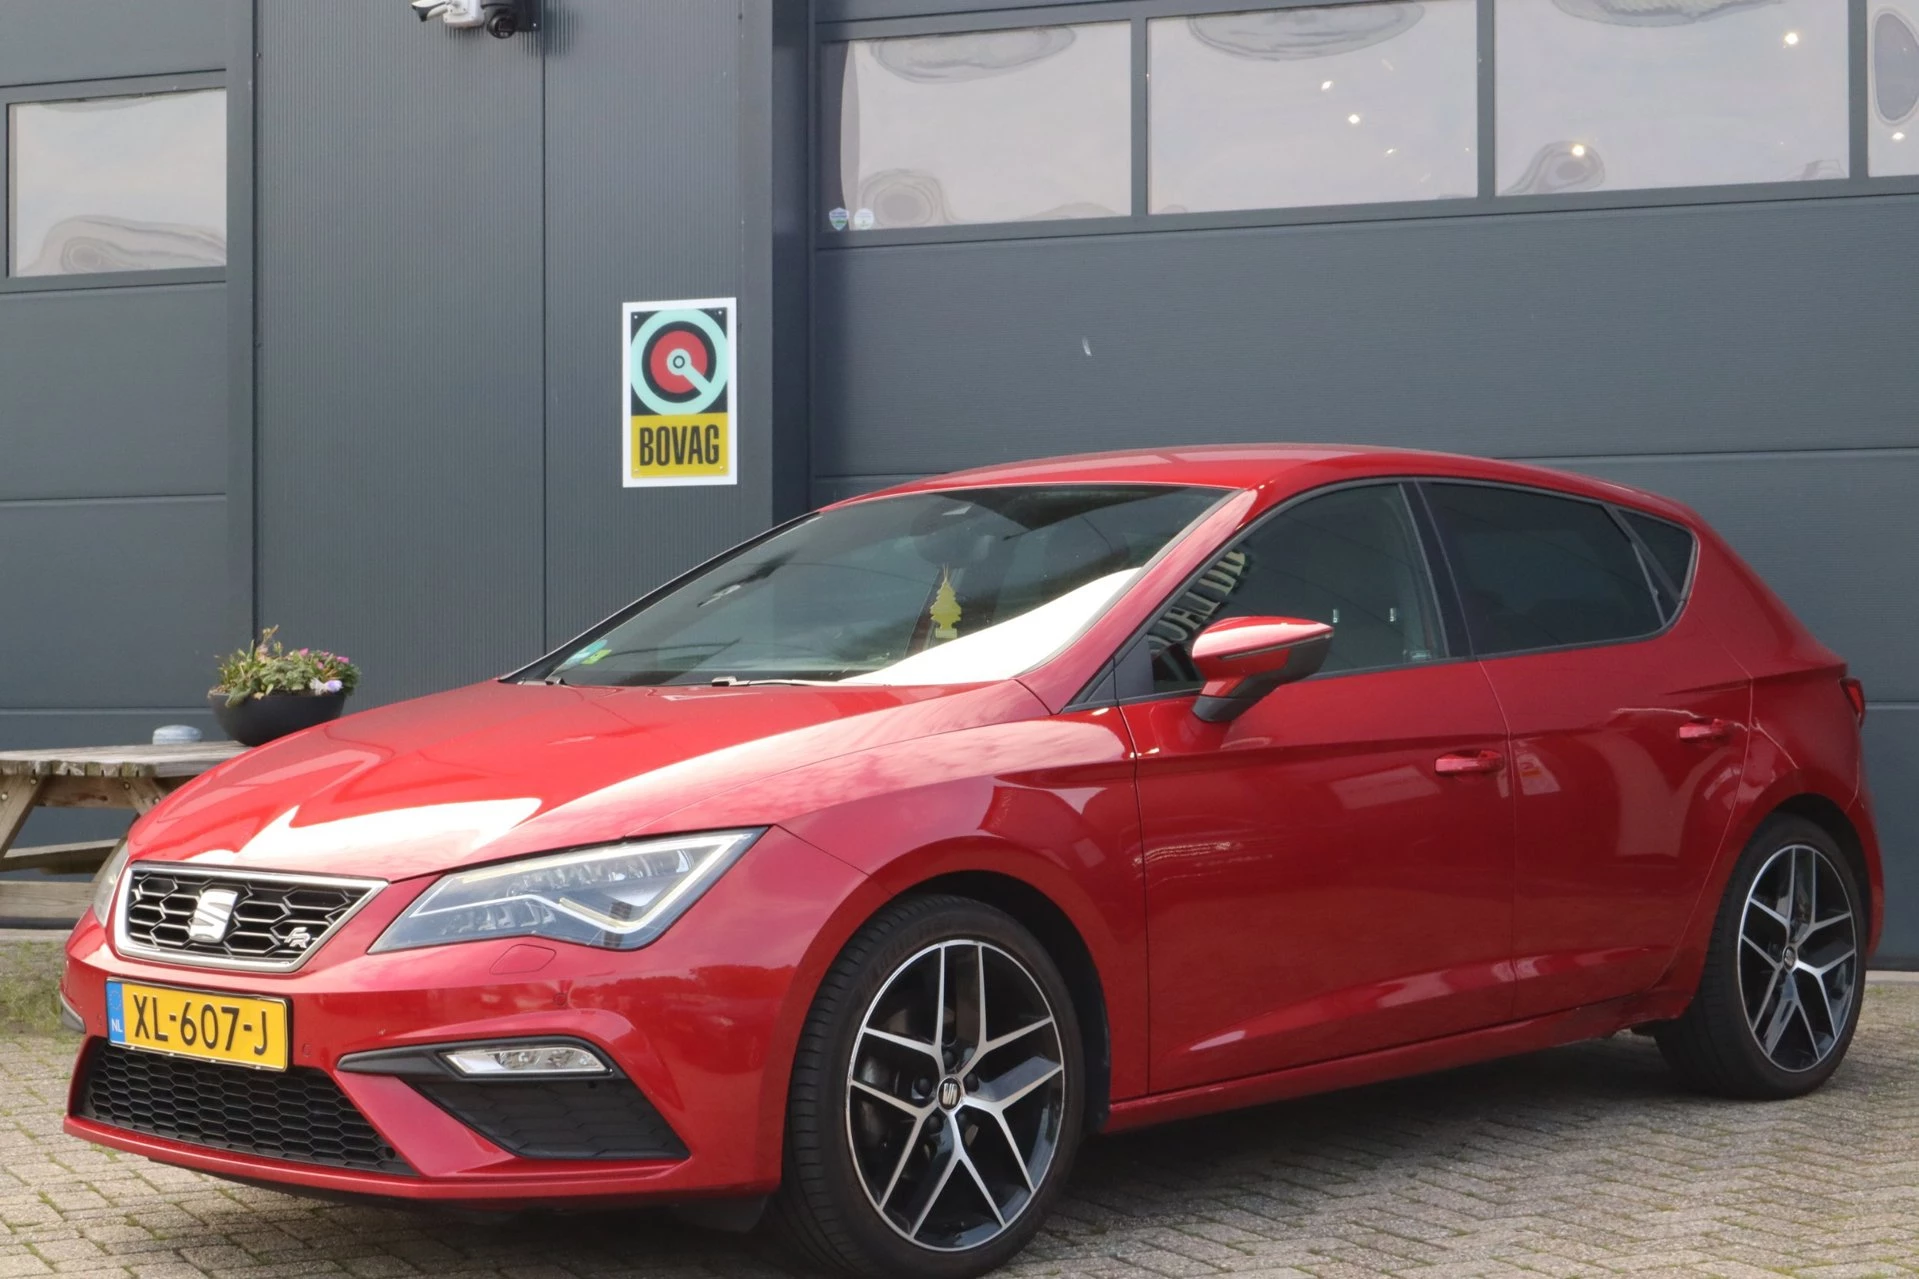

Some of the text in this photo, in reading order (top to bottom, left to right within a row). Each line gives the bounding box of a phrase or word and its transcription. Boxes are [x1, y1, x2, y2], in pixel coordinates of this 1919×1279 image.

[639, 424, 720, 467] BOVAG
[111, 1017, 124, 1033] NL
[133, 993, 269, 1056] XL-607-J
